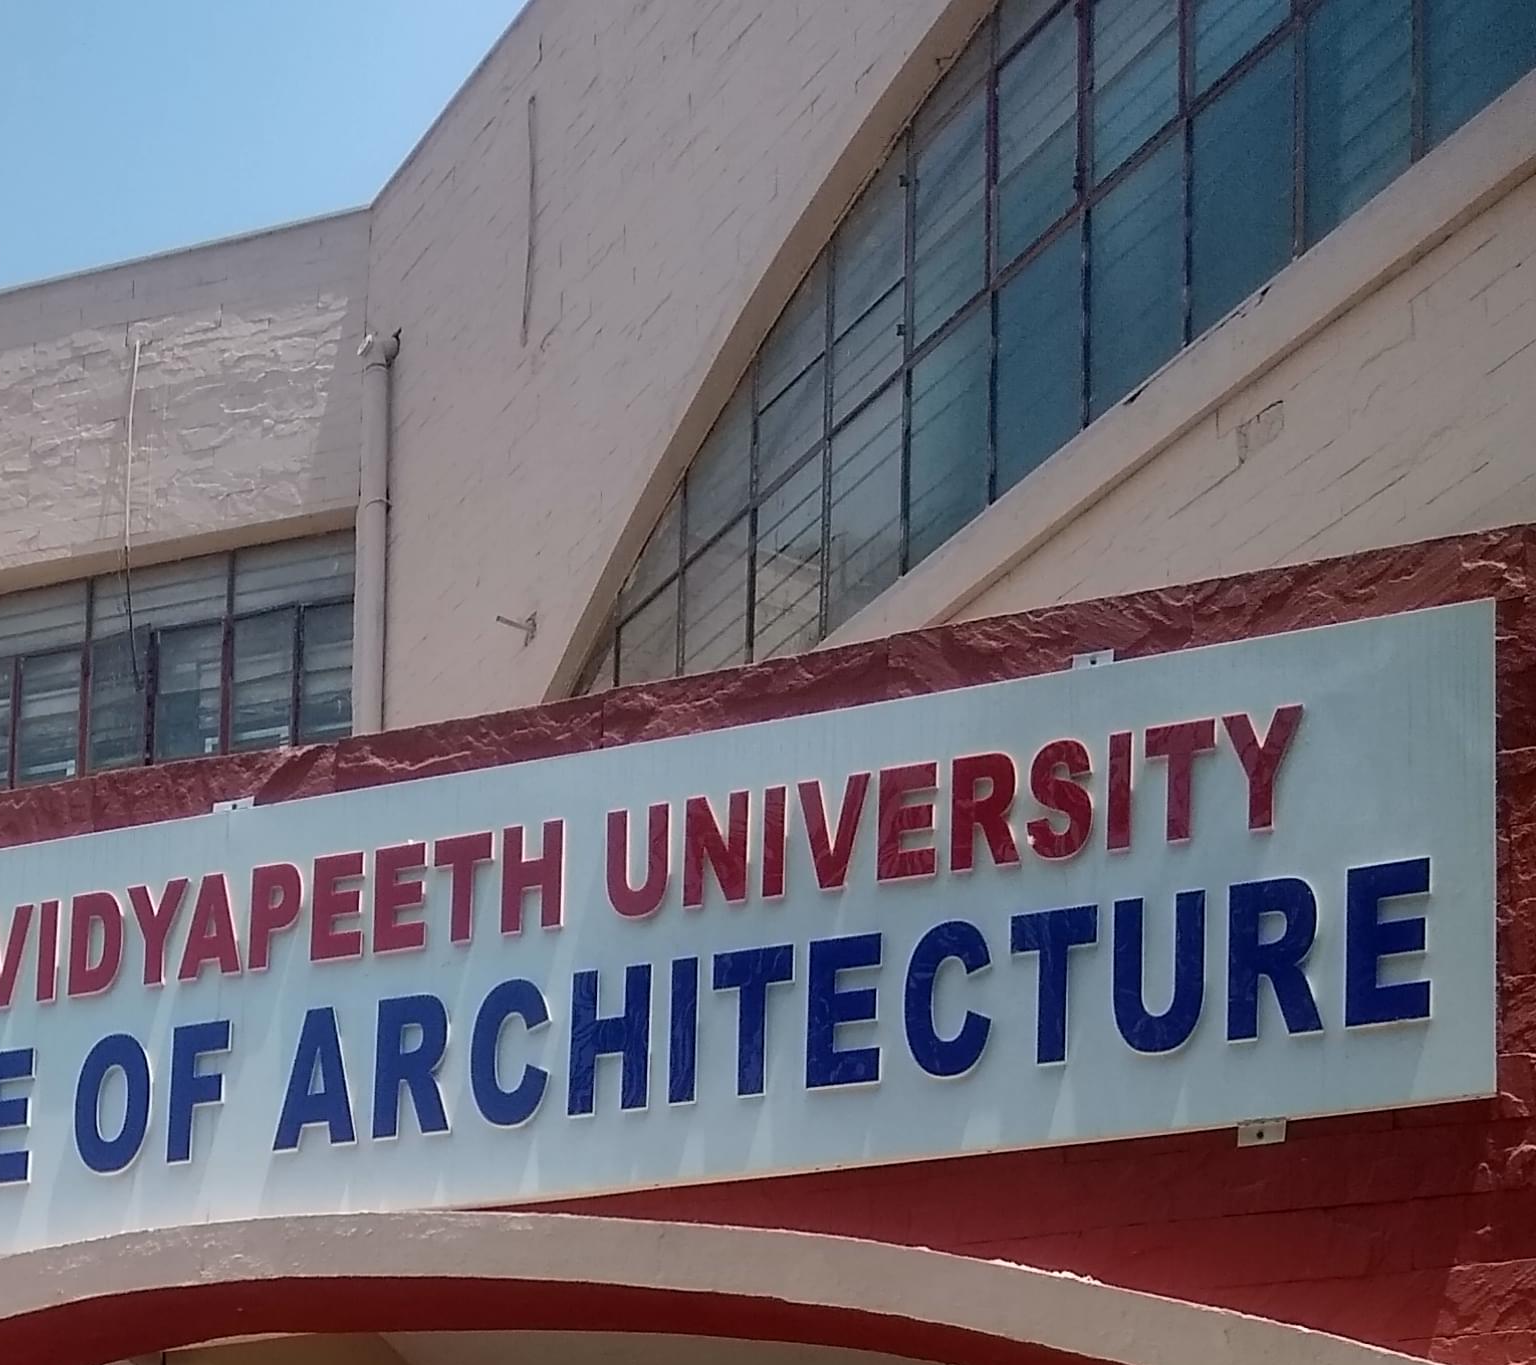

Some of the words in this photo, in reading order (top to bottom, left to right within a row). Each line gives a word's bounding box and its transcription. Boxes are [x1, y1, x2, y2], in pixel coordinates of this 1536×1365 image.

[605, 703, 1305, 919] UNIVERSITY
[74, 1019, 233, 1175] OF
[273, 856, 1433, 1152] ARCHITECTURE
